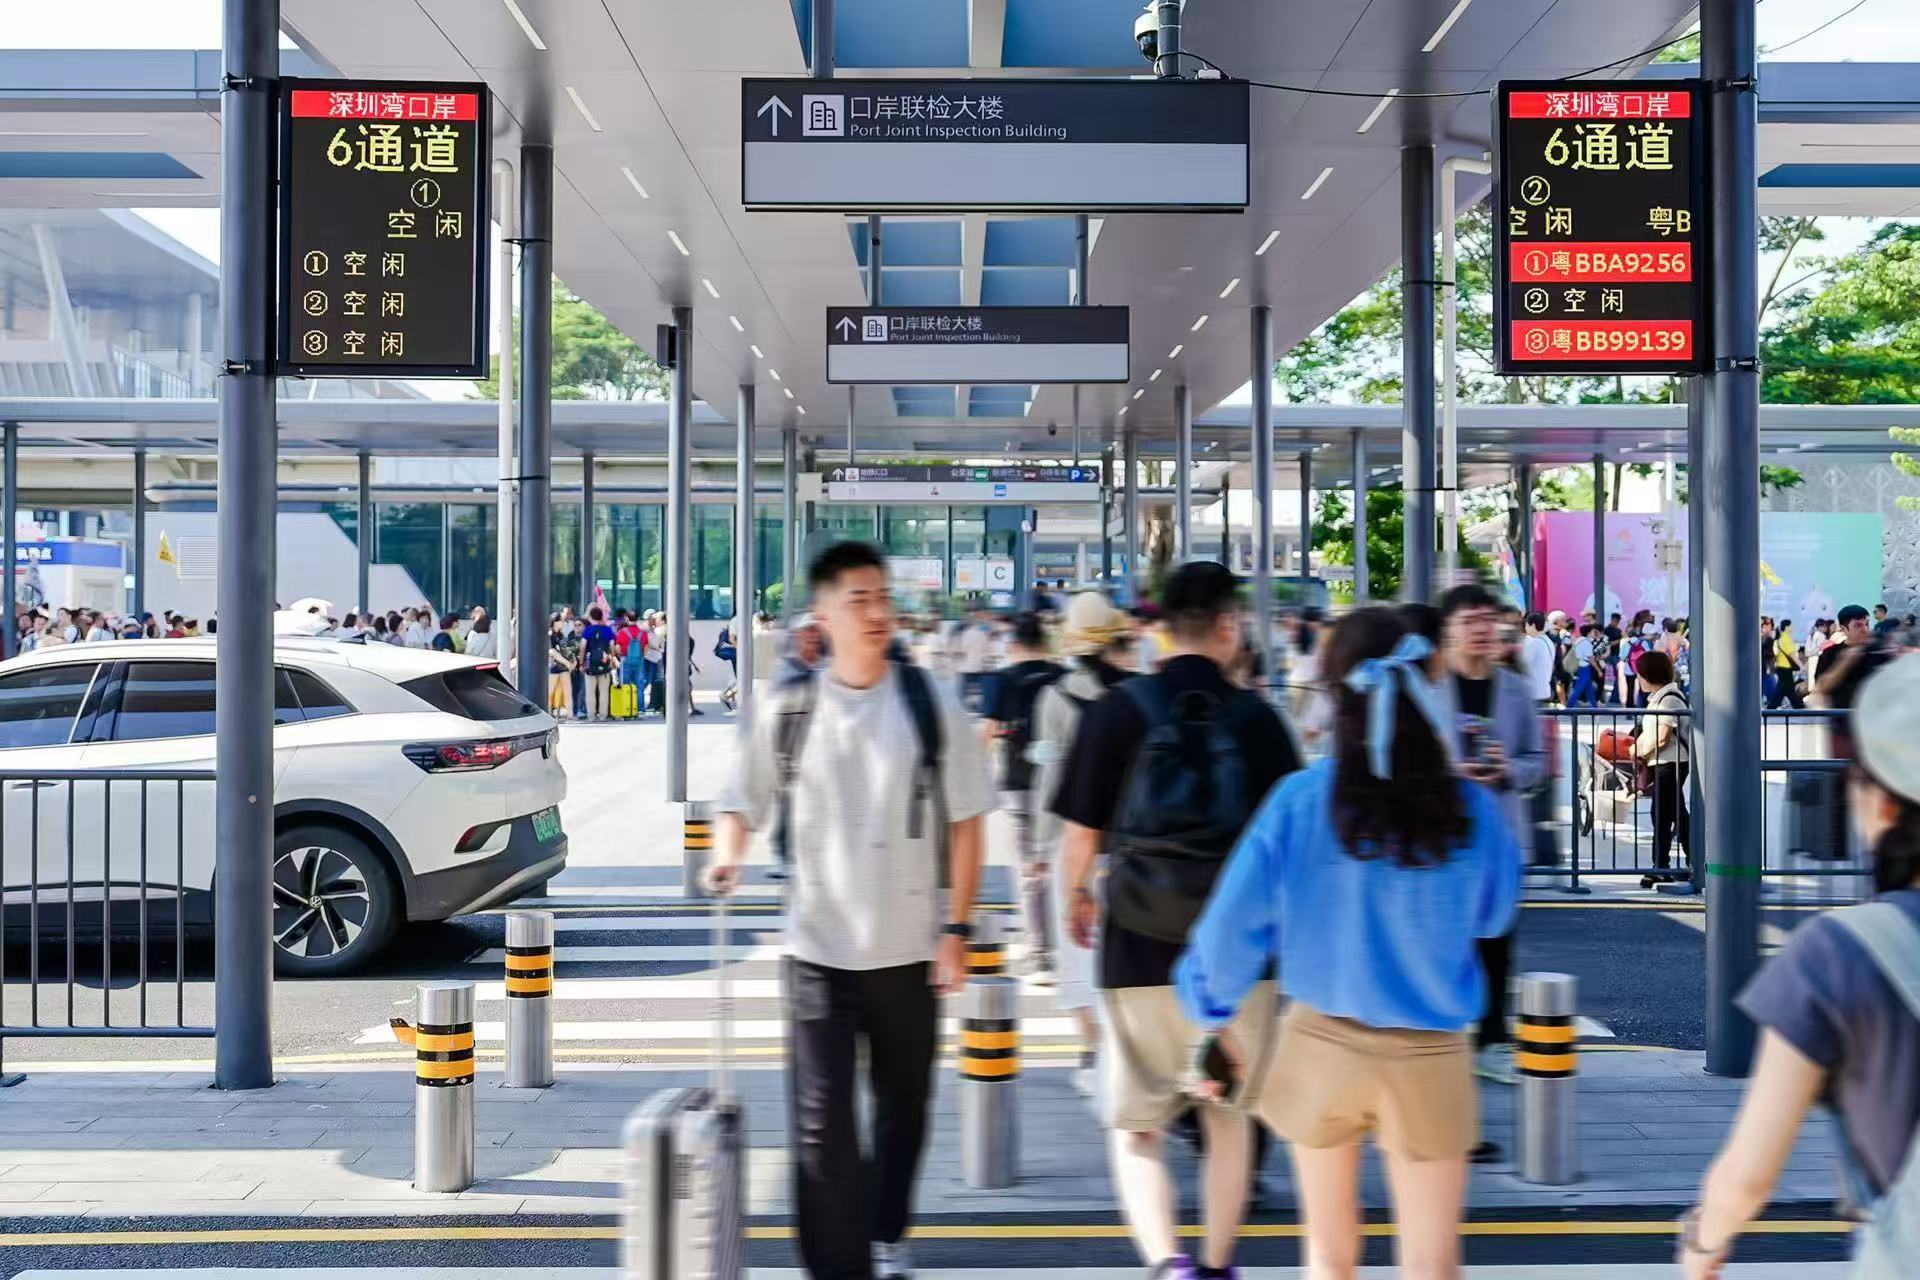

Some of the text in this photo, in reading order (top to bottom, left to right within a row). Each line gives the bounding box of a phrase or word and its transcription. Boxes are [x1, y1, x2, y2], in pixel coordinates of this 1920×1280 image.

[328, 92, 457, 119] 深圳湾口岸
[851, 95, 1004, 120] 口岸联检大楼
[1545, 92, 1670, 118] 深圳湾口岸
[850, 123, 1067, 140] Port Joint Inspection Building
[327, 124, 459, 173] 6通道
[1544, 122, 1673, 170] 6通道
[891, 316, 983, 331] 口岸联检大楼
[890, 333, 1020, 343] Port Joint Inspection Building
[994, 566, 1007, 580] C
